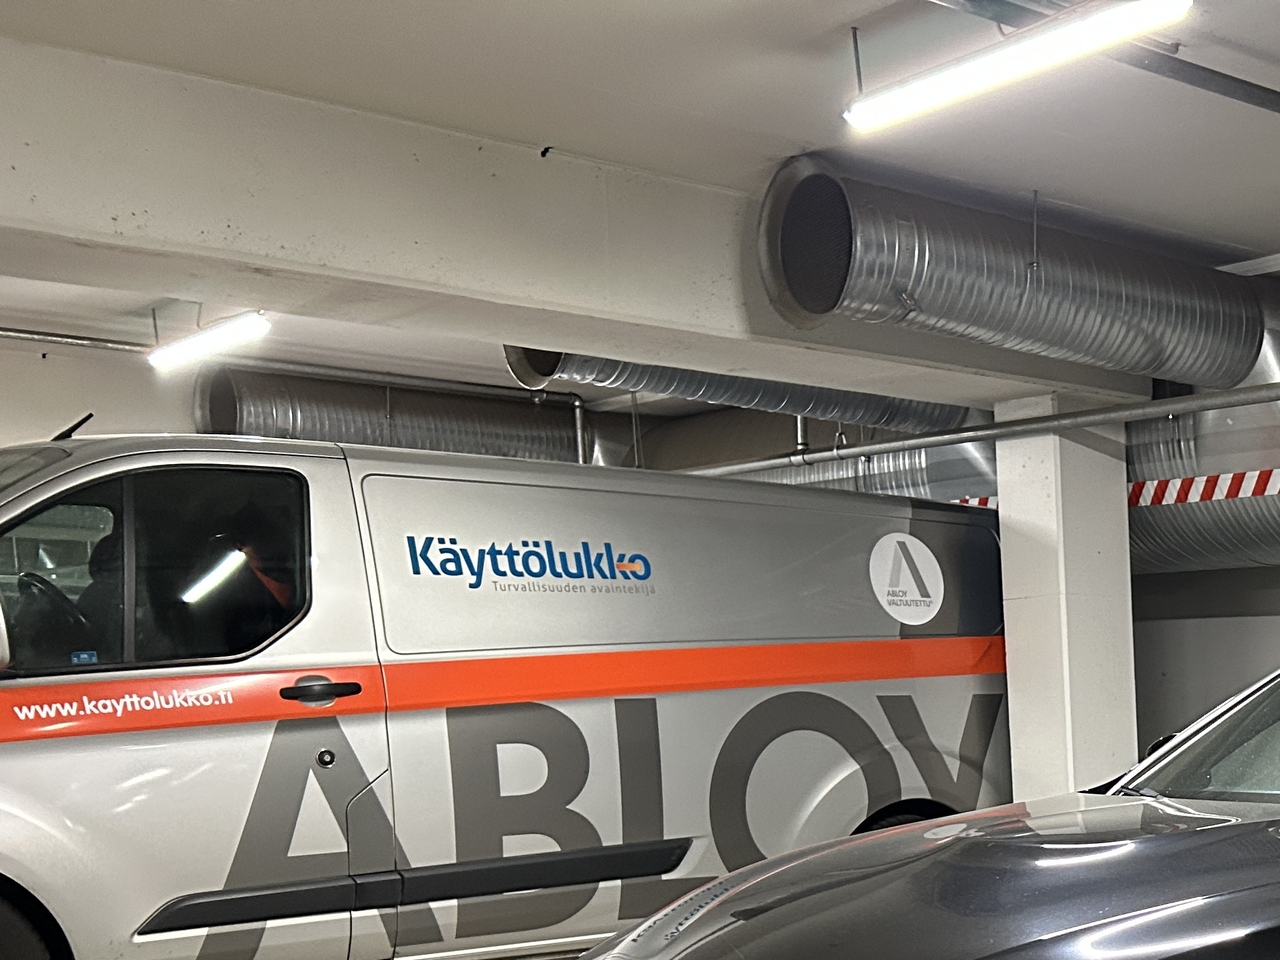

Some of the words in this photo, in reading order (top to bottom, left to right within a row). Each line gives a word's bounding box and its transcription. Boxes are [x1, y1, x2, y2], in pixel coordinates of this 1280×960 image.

[406, 535, 652, 589] Käyttölukko
[491, 580, 586, 593] Turvallisuuden
[590, 582, 656, 596] avaintekijä
[886, 589, 907, 598] ABLOY
